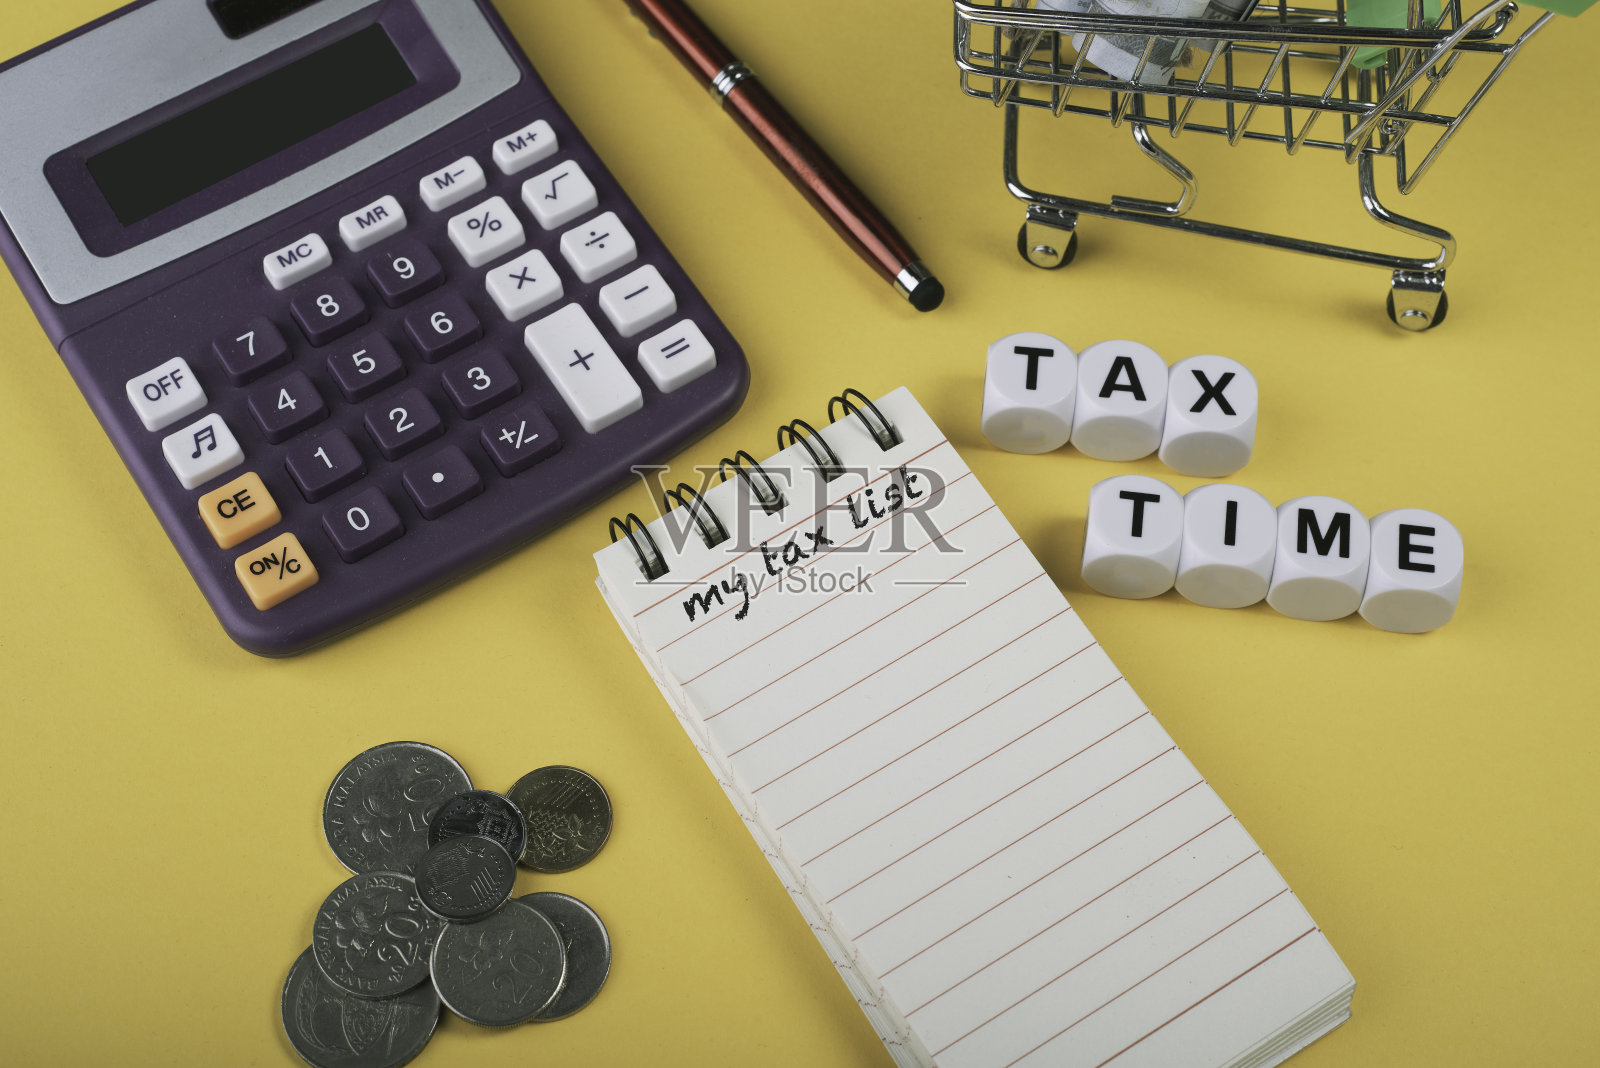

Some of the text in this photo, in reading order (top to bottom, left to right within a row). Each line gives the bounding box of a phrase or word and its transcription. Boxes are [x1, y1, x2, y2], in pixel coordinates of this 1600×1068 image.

[506, 131, 538, 153] M+
[355, 205, 389, 229] MR
[276, 242, 313, 268] MC
[392, 257, 416, 279] 9
[315, 294, 340, 317] 8
[429, 311, 454, 334] 6
[236, 330, 255, 356] 7
[351, 349, 376, 374] 5
[142, 368, 185, 402] OFF
[466, 366, 492, 391] 3
[1013, 345, 1238, 417] TAX
[277, 388, 297, 411] 4
[388, 407, 415, 432] 2
[313, 446, 334, 469] 1
[216, 488, 256, 519] CE
[346, 506, 370, 531] 0
[683, 463, 923, 622] my tax list
[1118, 489, 1437, 574] TIME
[249, 546, 301, 581] ON/C
[377, 915, 424, 967] 20
